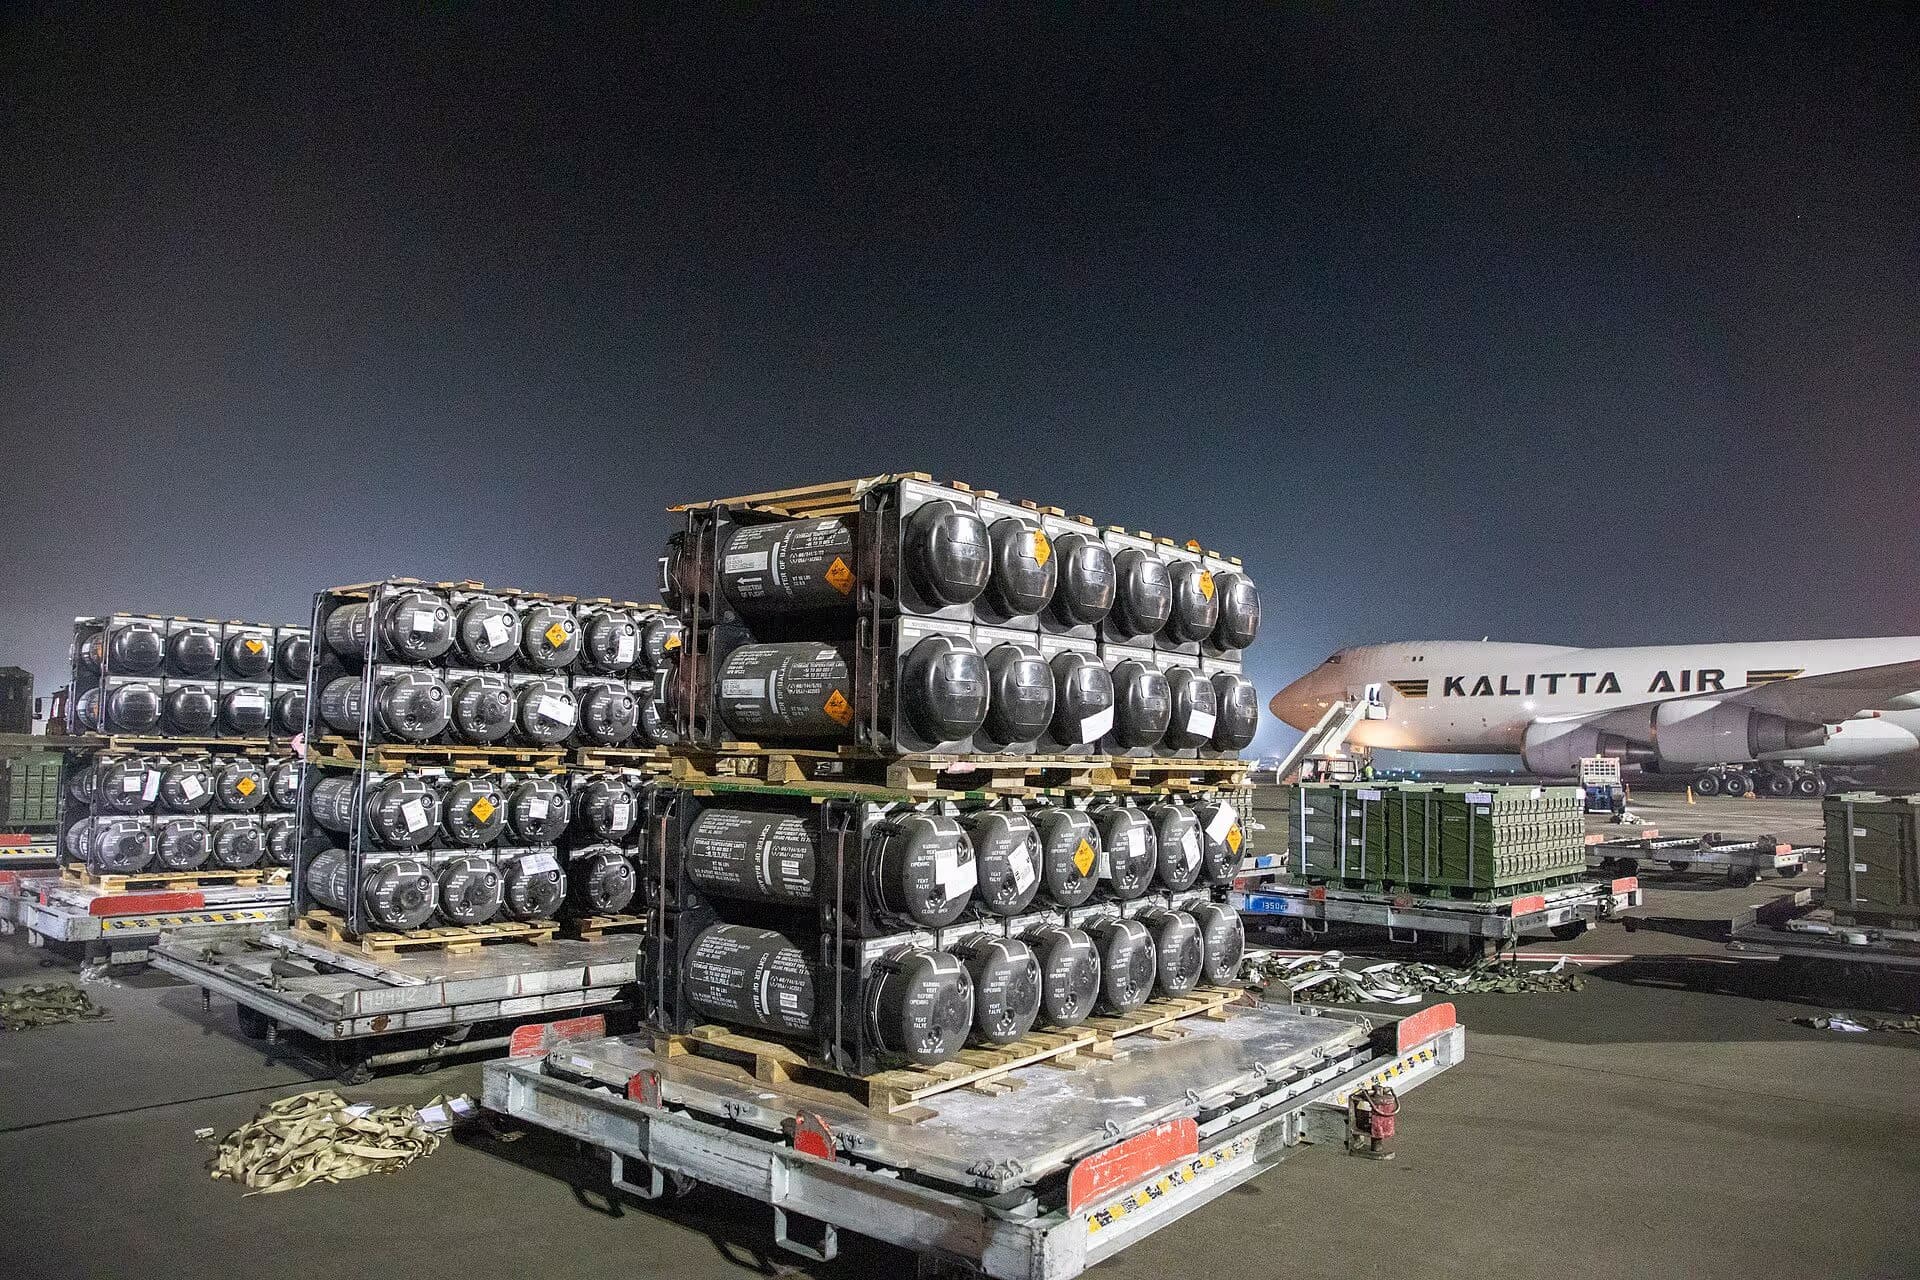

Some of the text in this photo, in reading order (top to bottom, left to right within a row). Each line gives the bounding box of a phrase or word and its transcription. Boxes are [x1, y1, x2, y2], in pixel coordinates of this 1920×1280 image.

[1443, 669, 1726, 697] KALITTA AIR
[755, 853, 761, 863] OF
[753, 952, 770, 980] CENTER
[753, 982, 759, 993] OF
